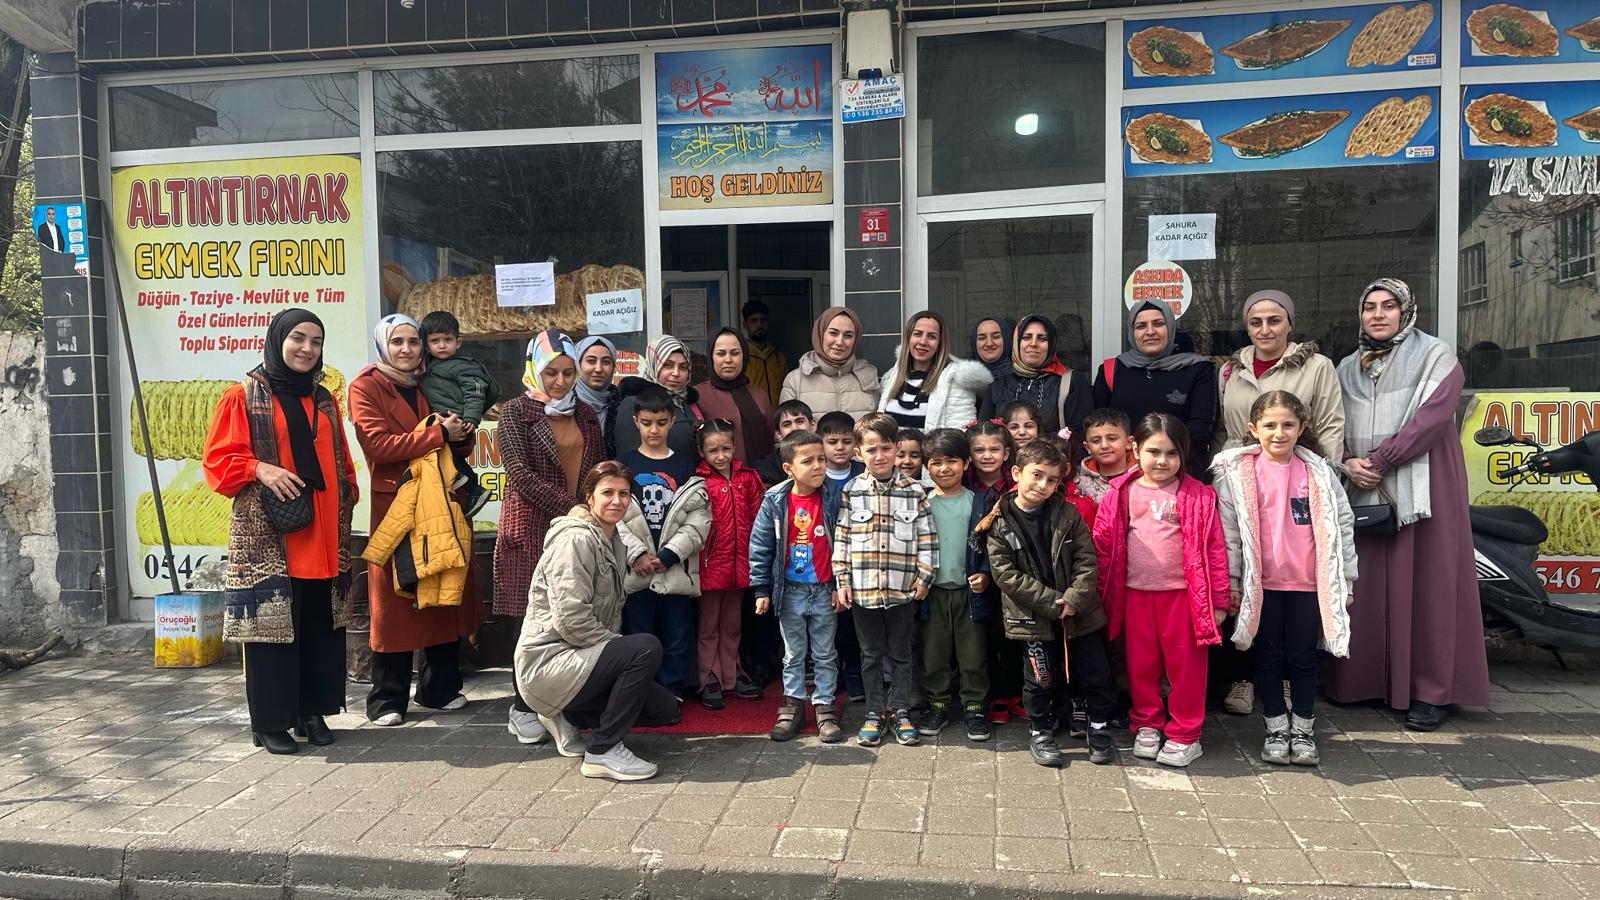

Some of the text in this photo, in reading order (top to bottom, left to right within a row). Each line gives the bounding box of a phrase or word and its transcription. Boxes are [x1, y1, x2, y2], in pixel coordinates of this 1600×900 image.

[864, 76, 897, 86] AMAÇ
[670, 165, 822, 203] HOŞ GELDİNİZ
[1488, 156, 1600, 202] TAŞIM
[127, 173, 350, 228] ALTINTIRNAK
[867, 218, 880, 230] 31
[1166, 221, 1197, 229] SAHURA
[1155, 232, 1208, 241] KADAR AÇIĞIZ
[134, 238, 346, 279] EKMEK FIRINI
[1132, 268, 1184, 284] ASKIDA
[137, 291, 180, 308] Düğün
[190, 290, 233, 308] Taziye
[243, 289, 290, 304] Mevlüt
[293, 294, 310, 303] ve
[315, 288, 345, 303] Tüm
[1132, 285, 1184, 300] EKMEK
[601, 297, 627, 306] SAHURA
[616, 306, 638, 315] AÇIĞIZ
[178, 311, 206, 328] Özel
[180, 336, 216, 353] Toplu
[160, 615, 197, 625] Oruçoğlu
